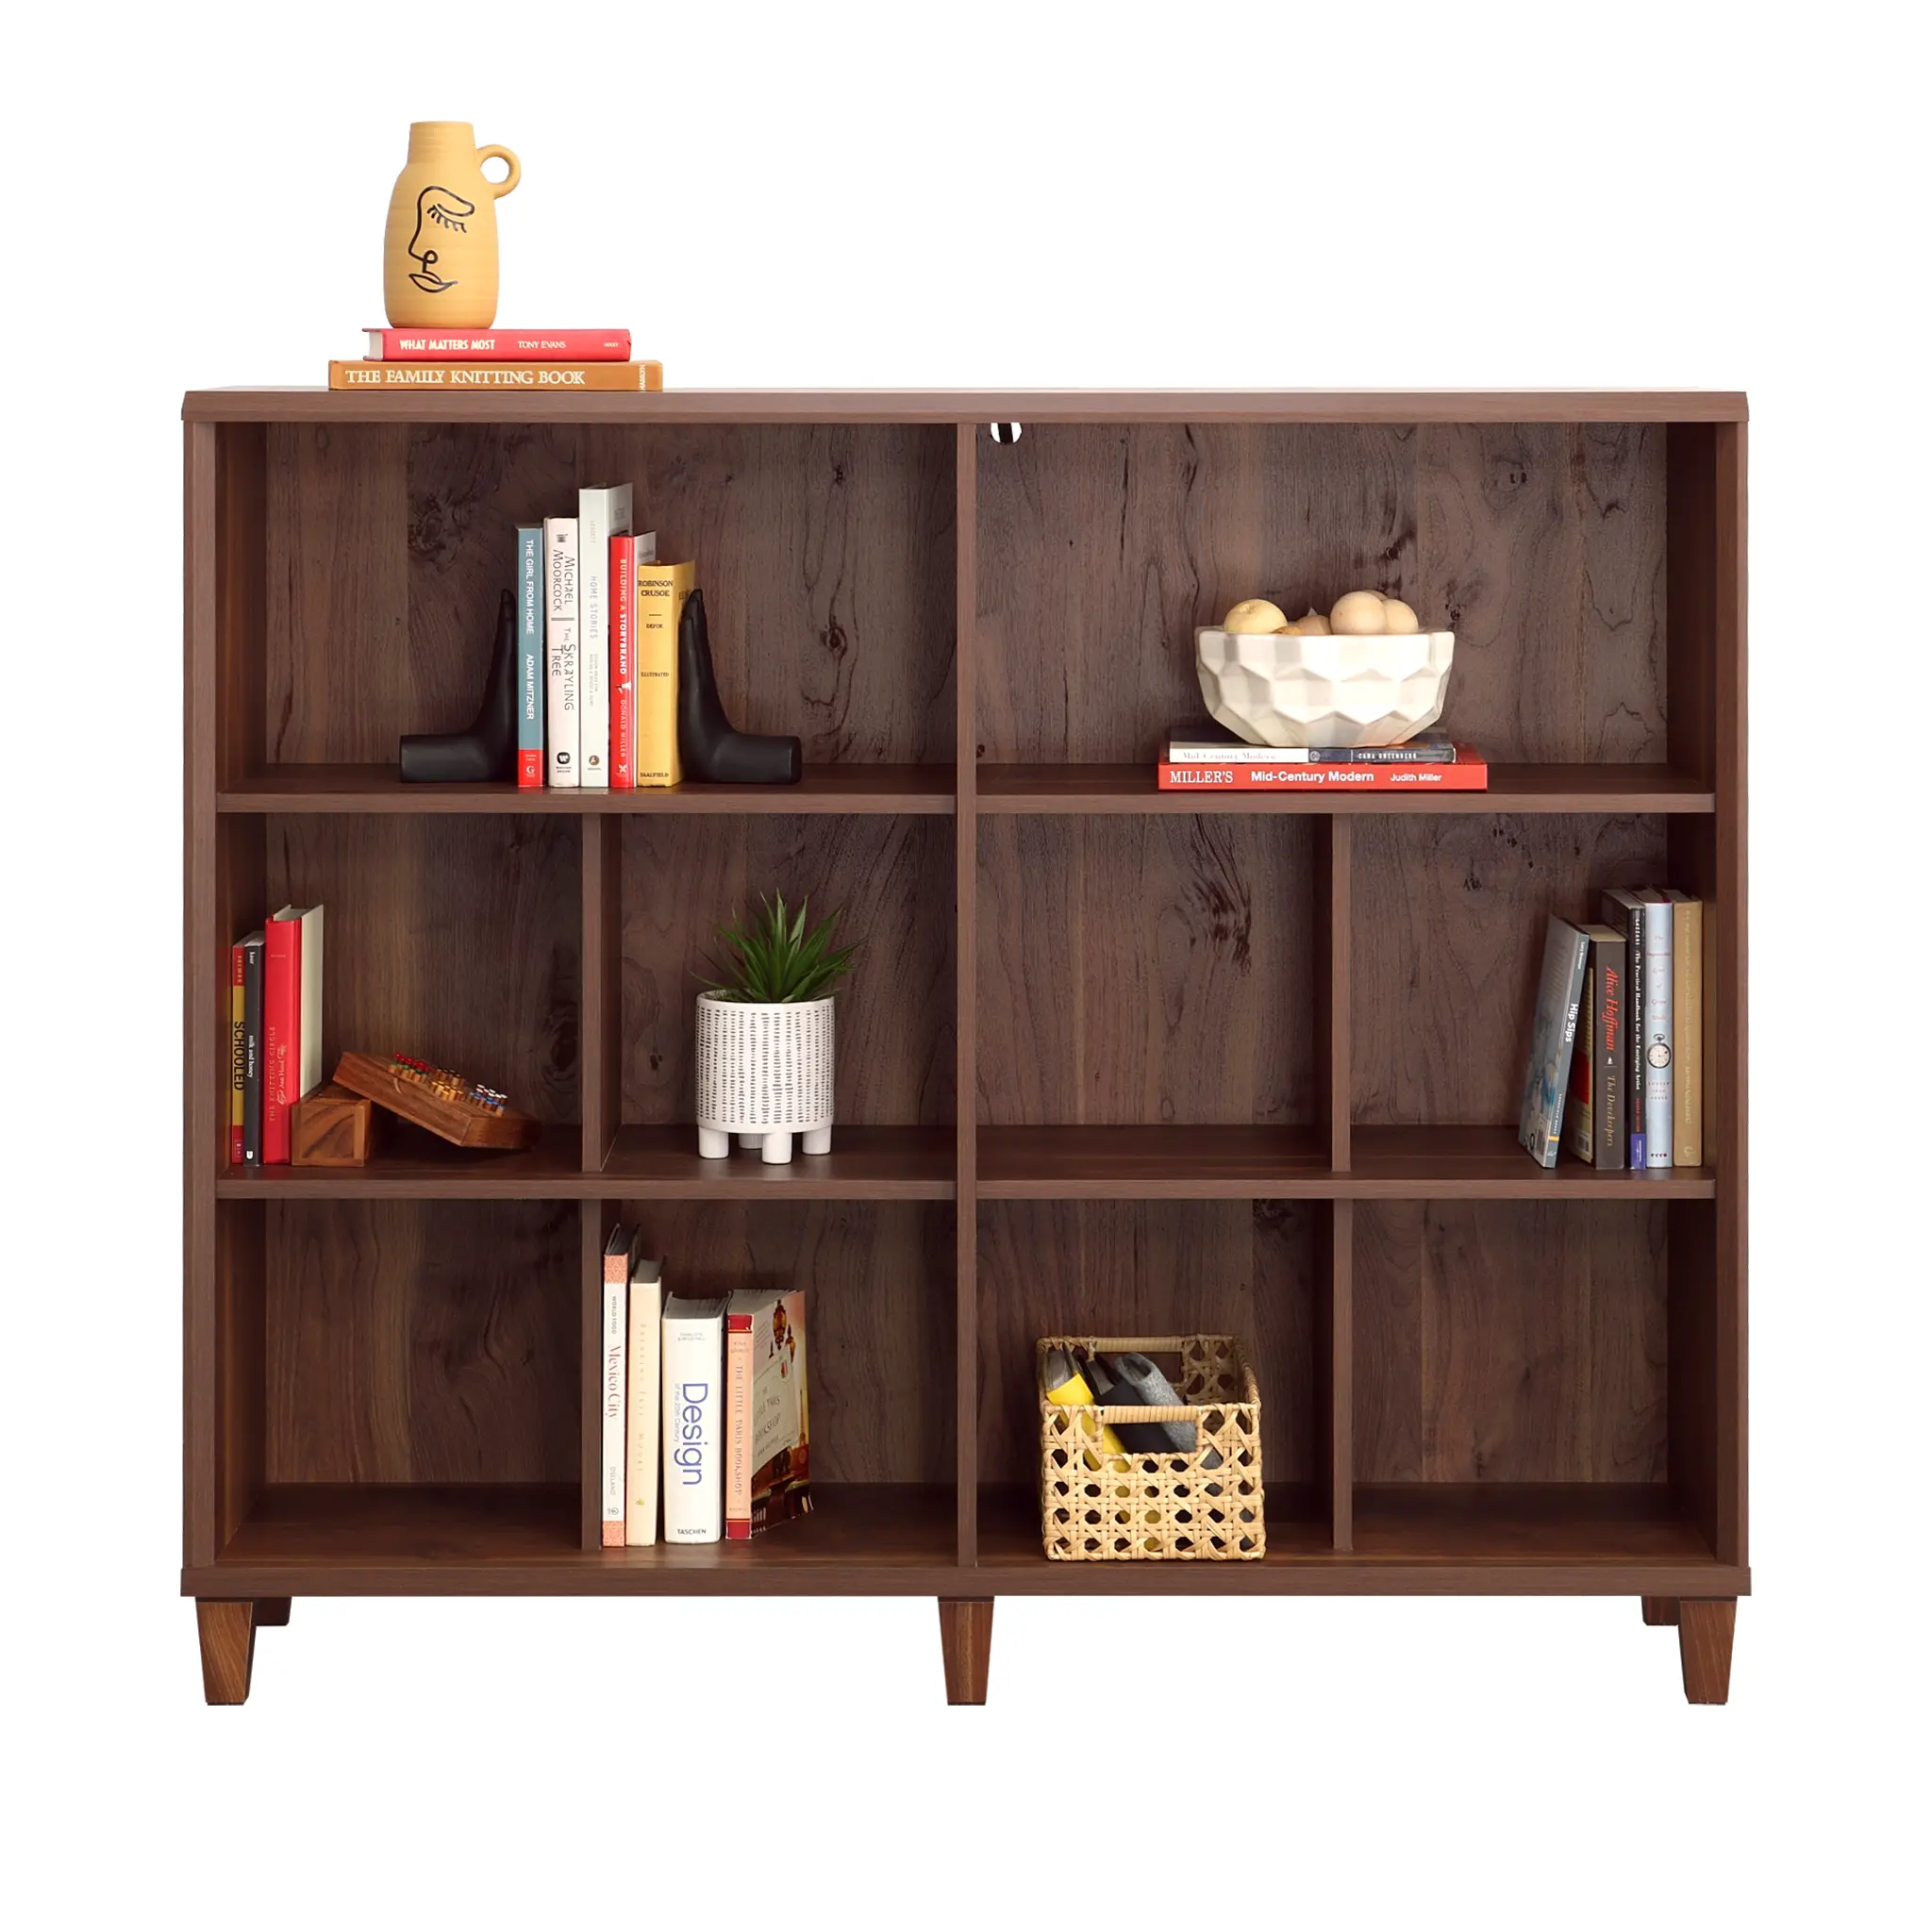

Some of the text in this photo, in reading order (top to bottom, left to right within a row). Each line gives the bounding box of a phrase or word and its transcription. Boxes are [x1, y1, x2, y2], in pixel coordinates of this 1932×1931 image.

[400, 339, 496, 350] WHAT MATTERS MOST
[517, 341, 566, 349] TONY EVANS
[345, 369, 586, 385] THE FAMILY KNITTING BOOK
[525, 540, 535, 635] THE GIRL FROM HOME
[552, 549, 564, 611] MOORCOCK
[590, 575, 598, 640] HOME STORIES
[619, 558, 627, 602] BUILDING
[551, 644, 564, 676] TREE
[618, 613, 627, 674] STORYBRAND
[525, 654, 535, 720] ADAM MITZNER
[563, 643, 576, 711] SKRAYLING
[619, 699, 627, 757] DONALD MILLER
[1170, 771, 1234, 784] MILLER'S
[1251, 771, 1374, 784] Mid-Century Modern
[1390, 774, 1442, 782] Judith Miller
[1565, 1004, 1579, 1042] Hip Sips
[1601, 966, 1618, 1051] Alice Hoffman
[233, 1021, 244, 1090] SCHOOLED
[1605, 1075, 1616, 1148] The Dovekeepers
[606, 1344, 622, 1420] Mexico City
[674, 1383, 708, 1485] Design
[734, 1366, 743, 1496] THE LITTLE PARIS BOOKSHOP
